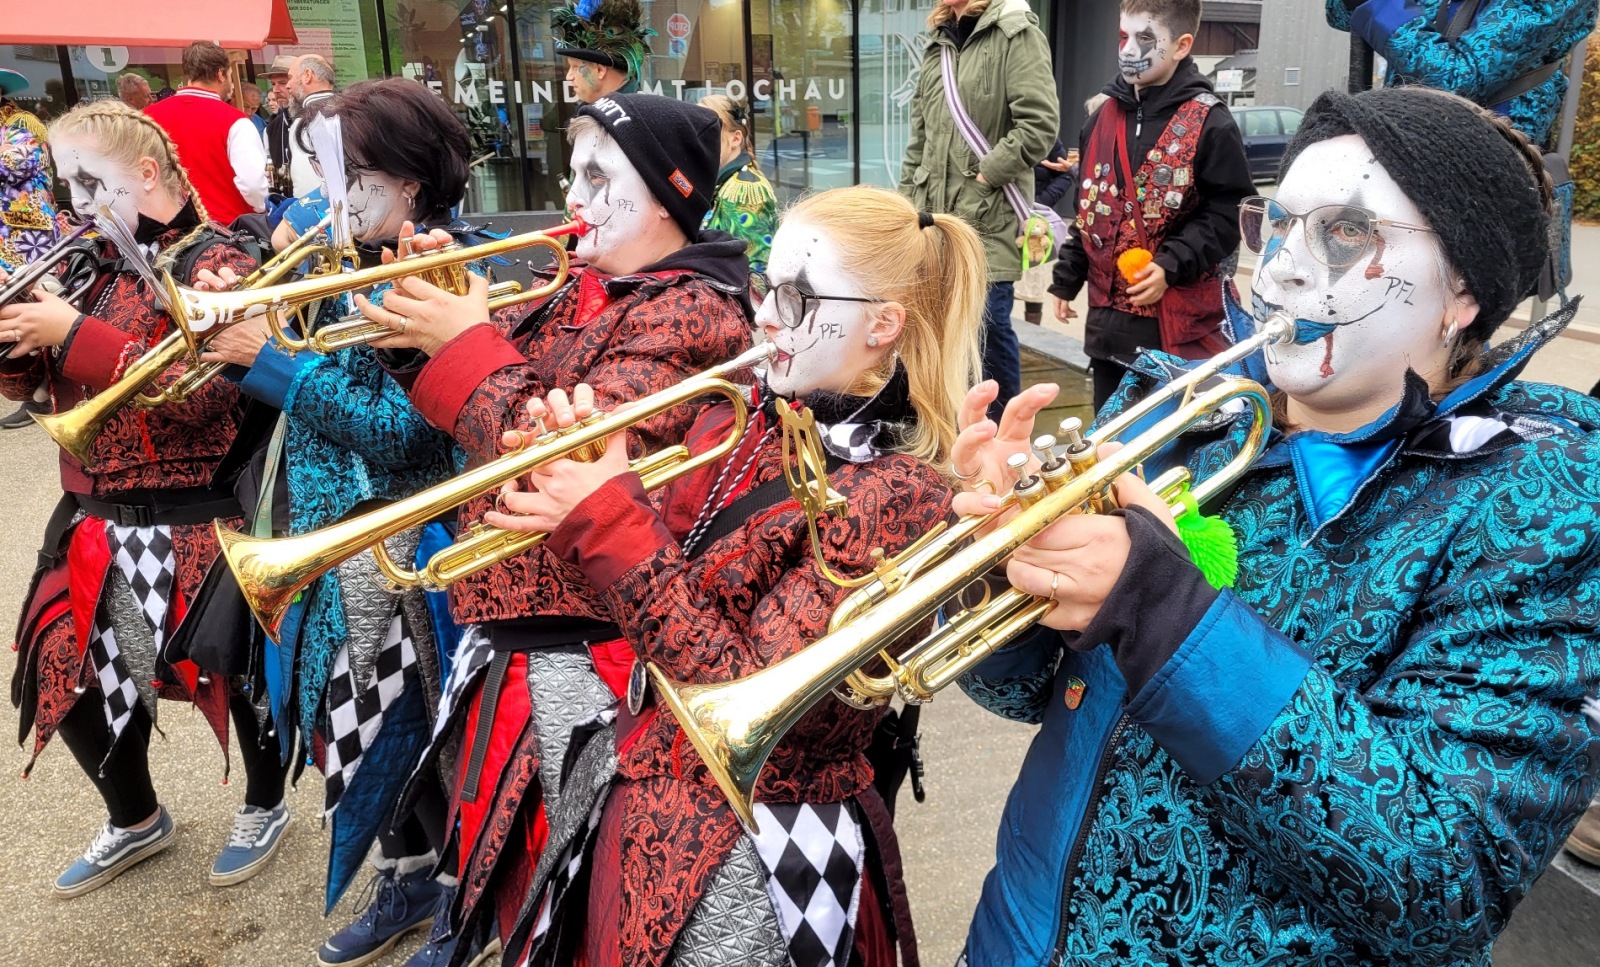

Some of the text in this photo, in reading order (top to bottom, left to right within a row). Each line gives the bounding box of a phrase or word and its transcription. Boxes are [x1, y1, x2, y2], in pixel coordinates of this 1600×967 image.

[616, 198, 638, 213] PFL
[1382, 275, 1418, 306] PFL
[817, 322, 847, 340] PFL
